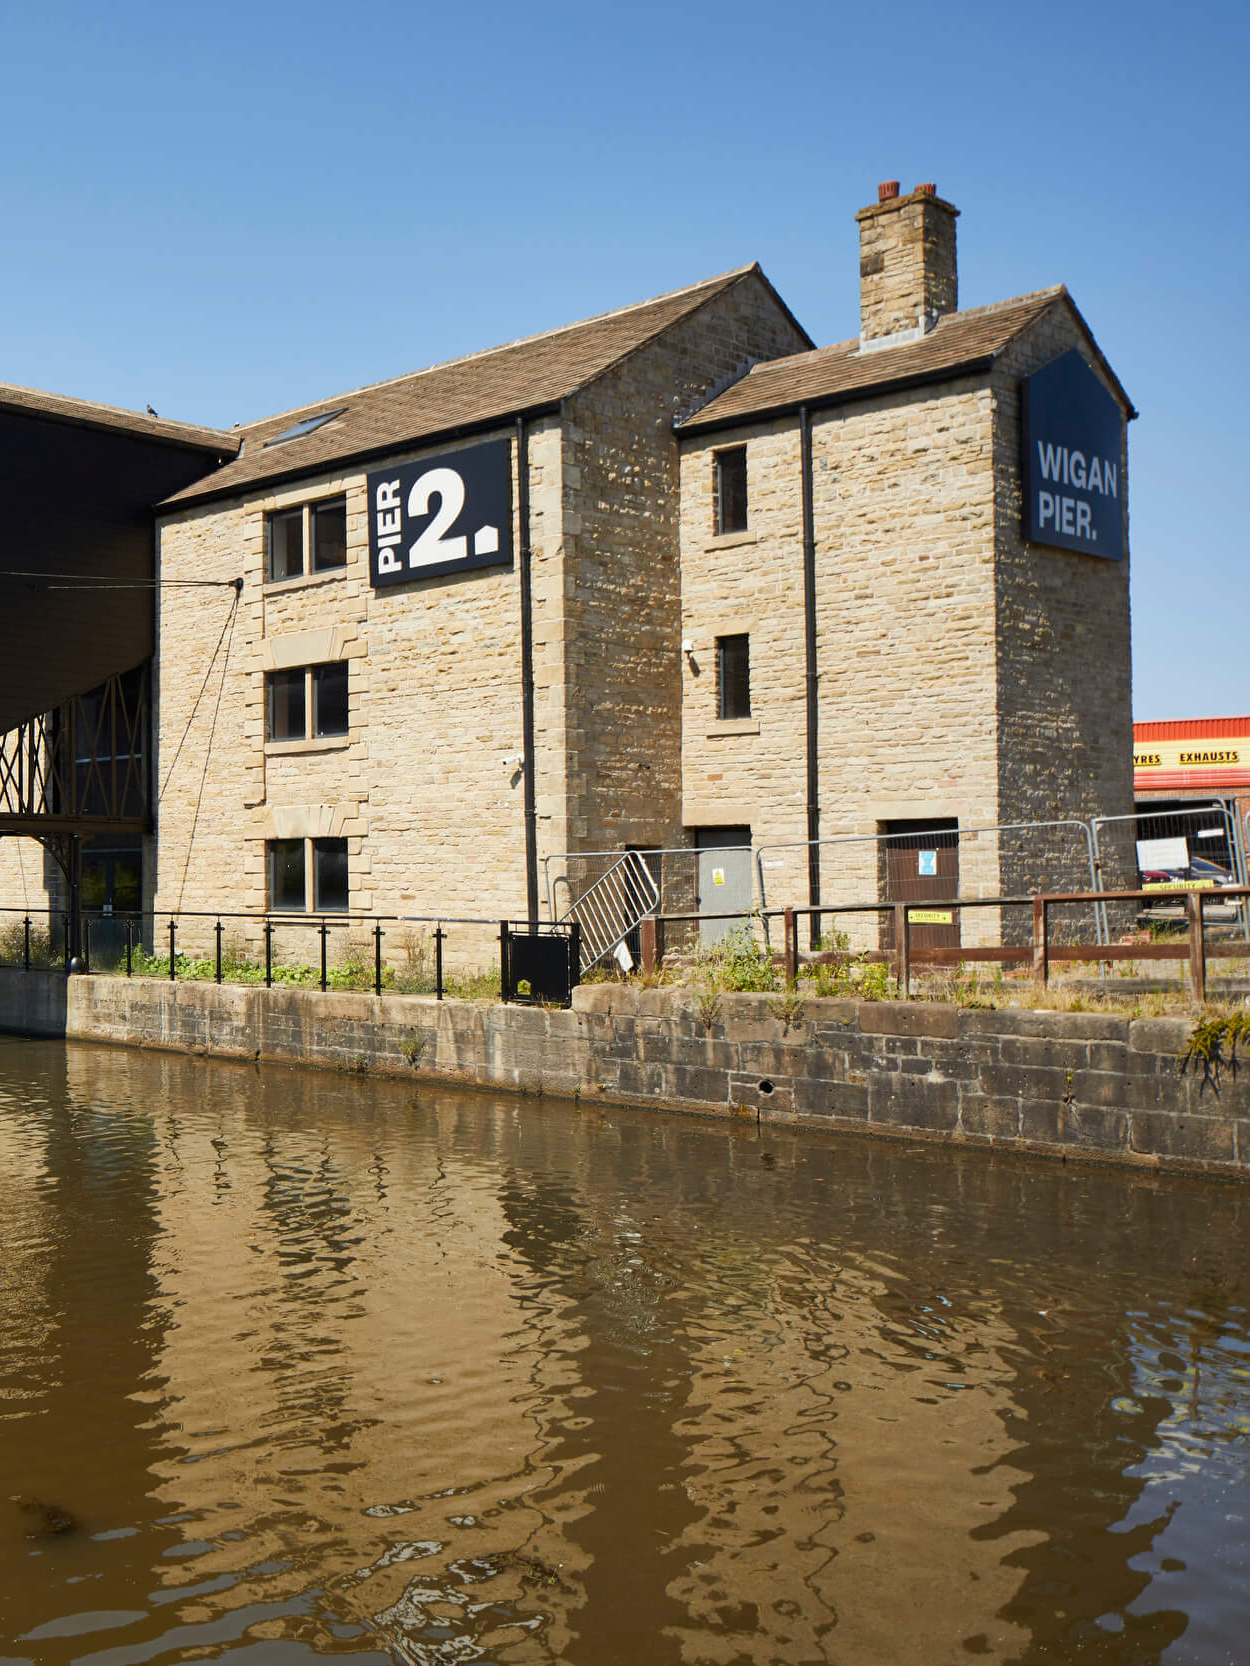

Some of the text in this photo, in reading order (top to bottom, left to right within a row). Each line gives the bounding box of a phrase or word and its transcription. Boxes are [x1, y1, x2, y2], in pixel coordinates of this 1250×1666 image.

[1037, 440, 1117, 499] WIGAN
[376, 479, 402, 575] PIER
[1134, 751, 1238, 765] YRES EXHAUSTS
